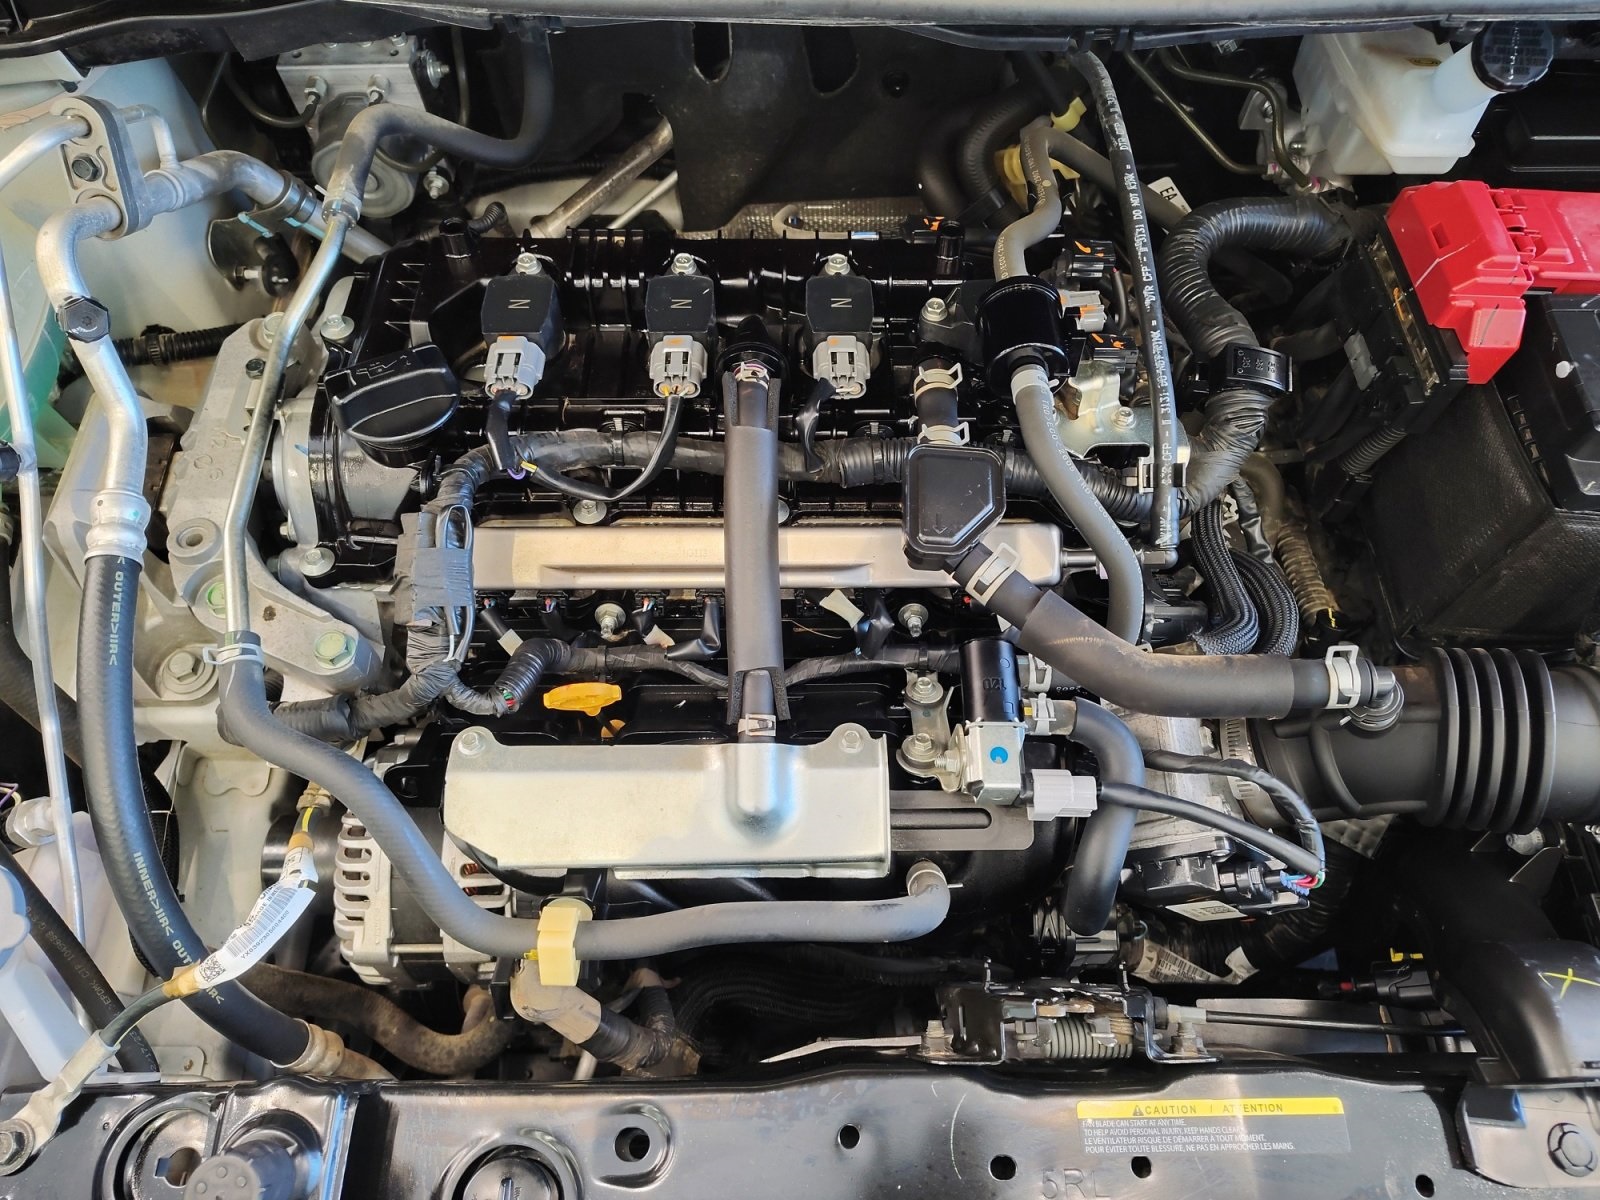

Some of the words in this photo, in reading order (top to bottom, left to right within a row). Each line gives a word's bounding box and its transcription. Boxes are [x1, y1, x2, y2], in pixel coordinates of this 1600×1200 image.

[1141, 266, 1153, 282] CFP
[1144, 1105, 1197, 1115] CAUTION
[1222, 1103, 1283, 1113] ATENTION
[1095, 1119, 1117, 1128] BLADE
[1117, 1119, 1130, 1128] CAN
[1130, 1119, 1148, 1127] START
[1149, 1119, 1157, 1127] AT
[1084, 1128, 1093, 1137] TO
[1093, 1128, 1109, 1136] HELP
[1109, 1128, 1129, 1136] AVOID
[1129, 1127, 1161, 1136] PERSONAL
[1184, 1127, 1199, 1135] KEEP
[1199, 1127, 1221, 1135] HANDS
[1091, 1136, 1137, 1145] VENTILATEUR
[1137, 1135, 1161, 1145] RISQUE
[1161, 1135, 1172, 1144] DE
[1216, 1133, 1234, 1142] TOUT
[1085, 1145, 1105, 1153] POUR
[1129, 1144, 1151, 1153] TOUTE
[1186, 1143, 1196, 1152] NE
[1196, 1143, 1209, 1152] PAS
[1209, 1143, 1219, 1152] EN
[1219, 1142, 1262, 1151] APPROCHER
[1261, 1142, 1272, 1151] LES
